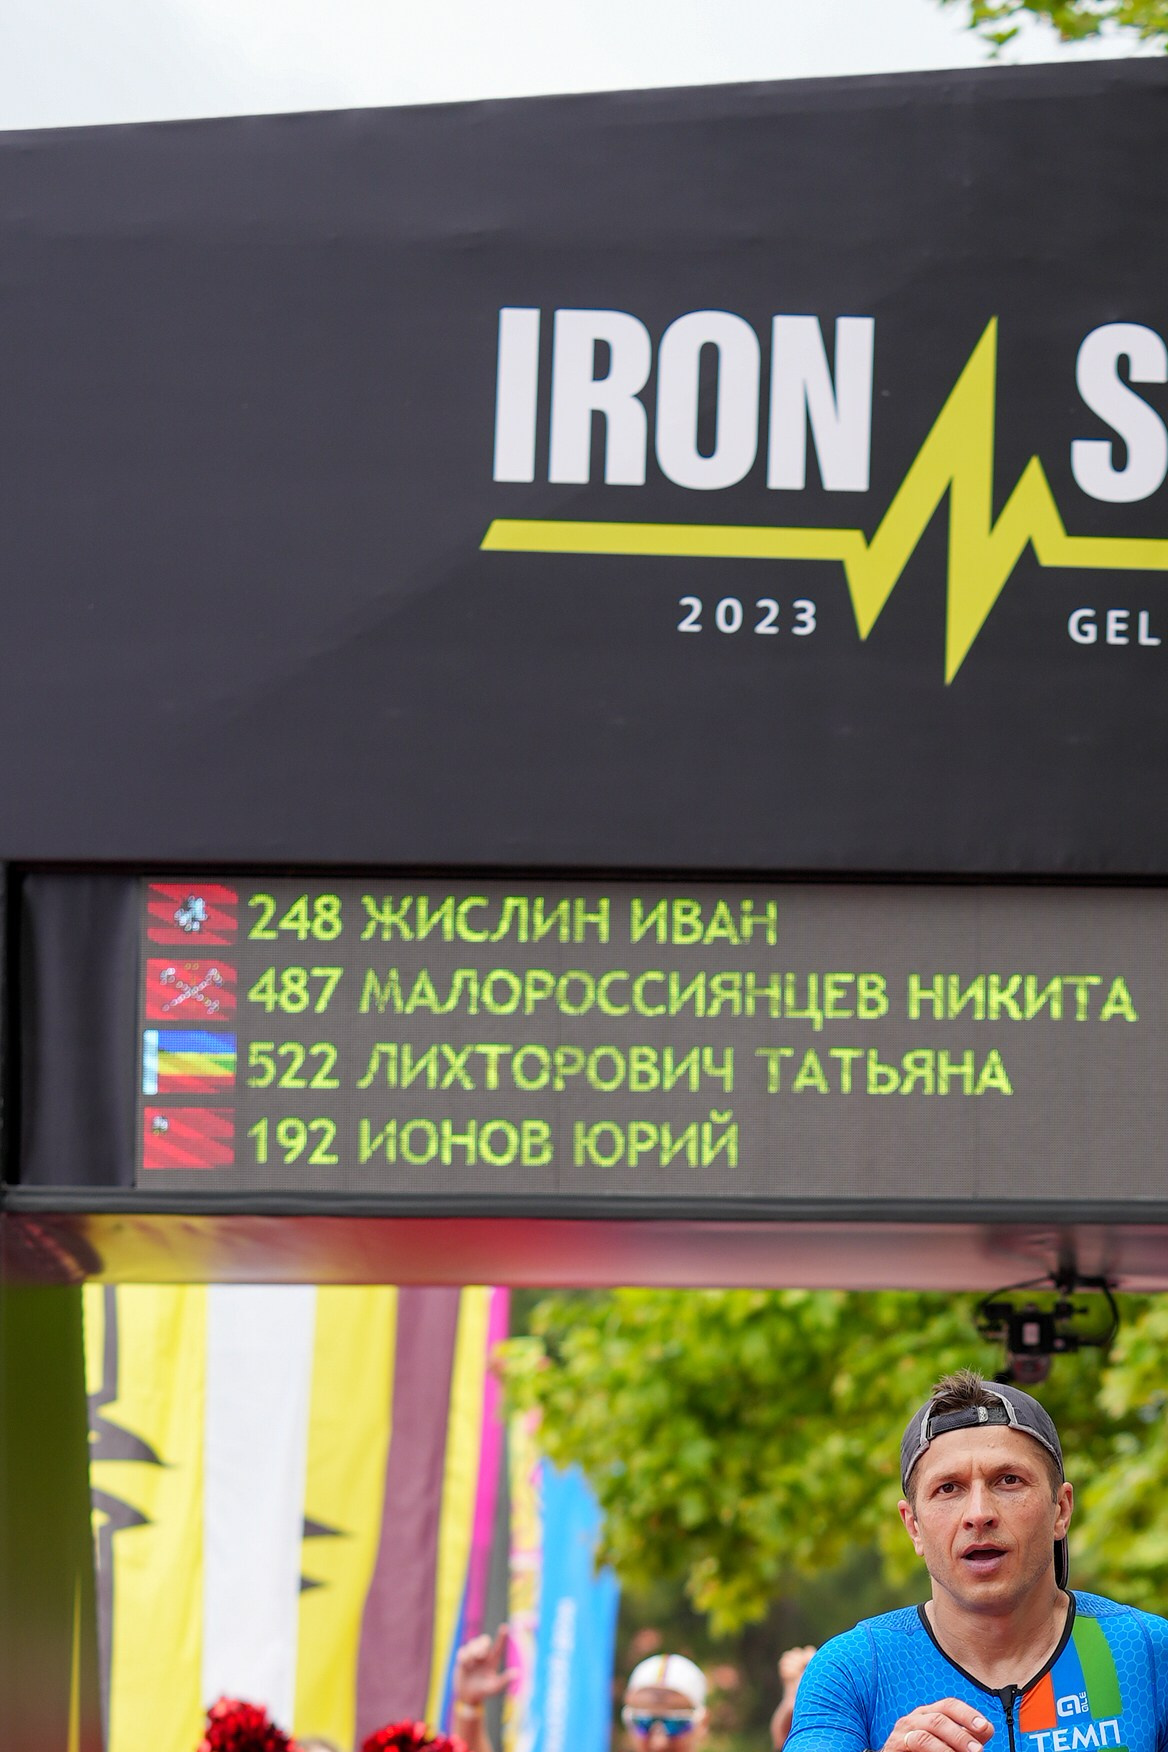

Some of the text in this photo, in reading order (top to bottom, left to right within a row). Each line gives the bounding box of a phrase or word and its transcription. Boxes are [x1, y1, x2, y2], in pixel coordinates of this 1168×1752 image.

[493, 307, 874, 491] IRON
[677, 596, 817, 636] 2023
[248, 892, 778, 946] 248 ЖИСЛИН ИВАН
[248, 966, 1138, 1031] 487 МАЛОРОССИЯНЦЕВ НИКИТА
[248, 1041, 1013, 1096] 522 ЛИХТОРОВИЧ ТАТЬЯНА
[248, 1110, 740, 1169] 192 ИОНОВ ЮРИЙ
